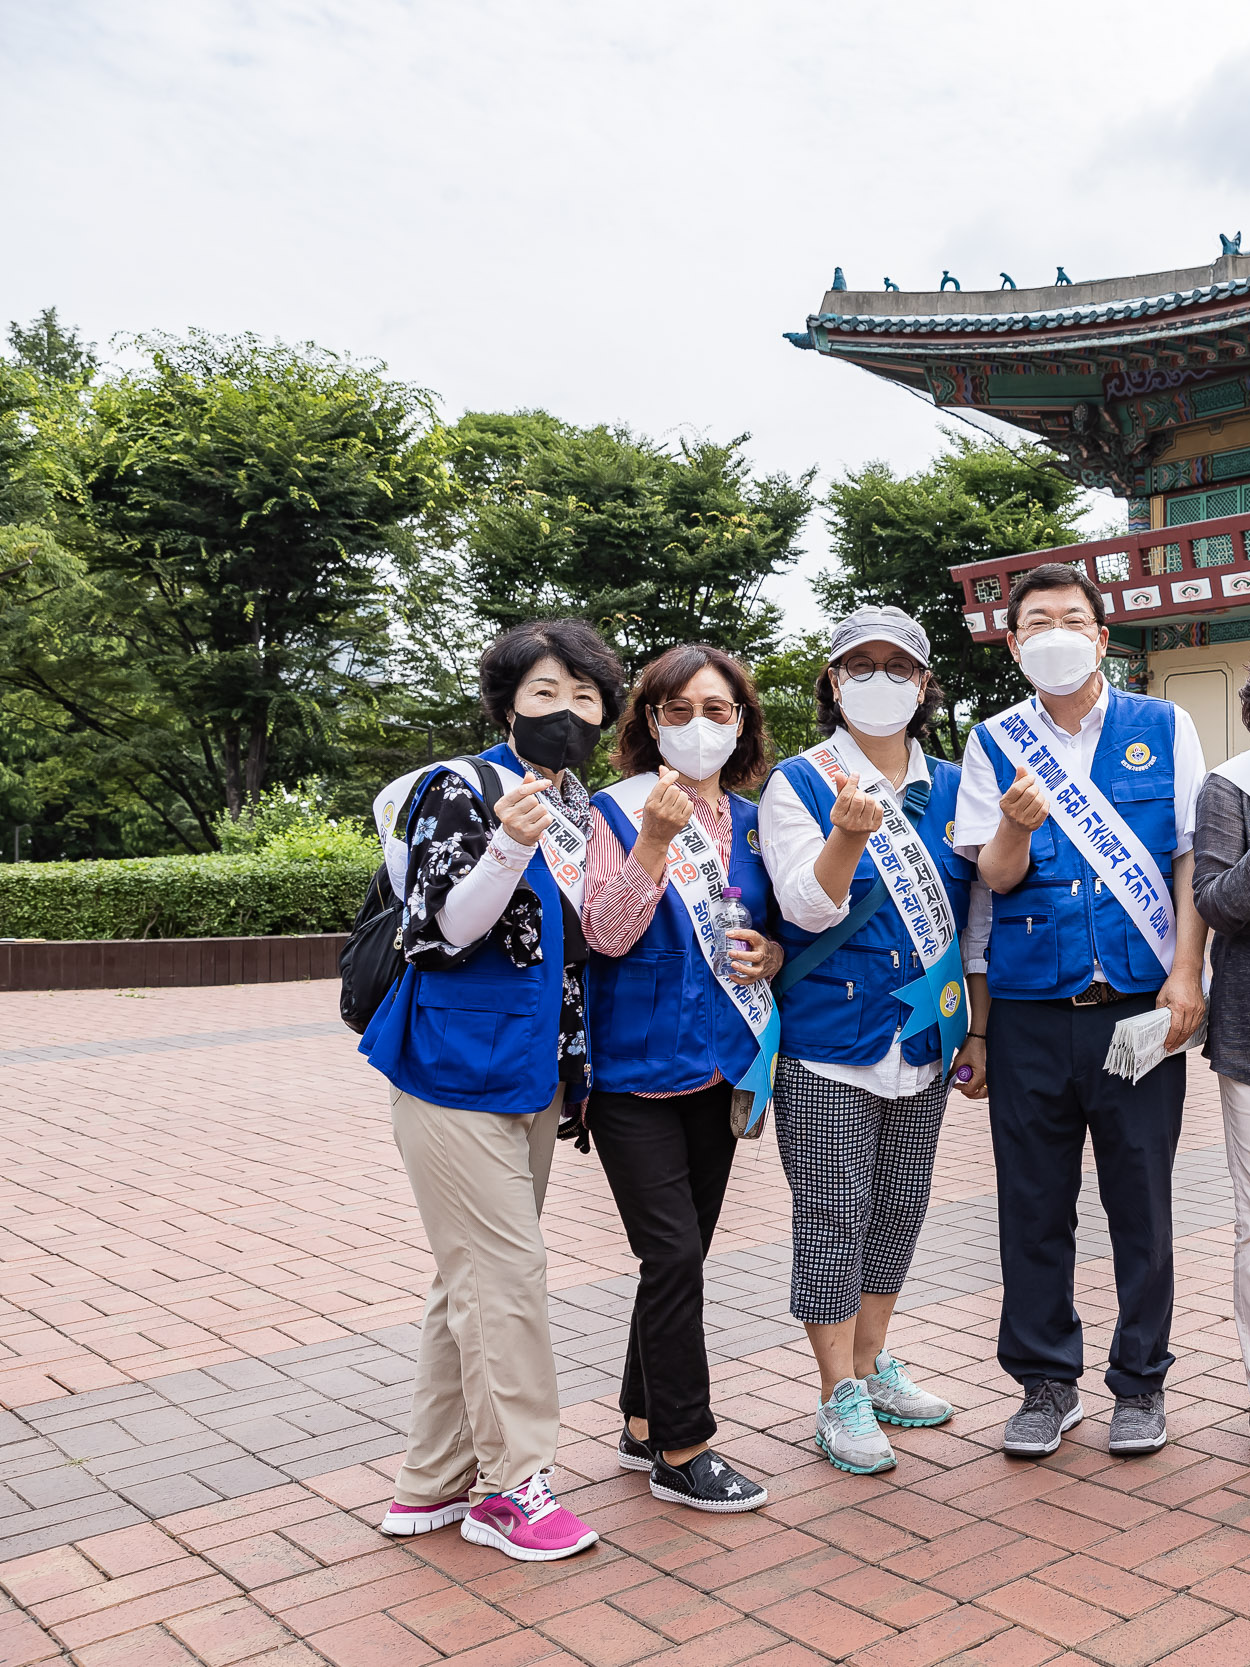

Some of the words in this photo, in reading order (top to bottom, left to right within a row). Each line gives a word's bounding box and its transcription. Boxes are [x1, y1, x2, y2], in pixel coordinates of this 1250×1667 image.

[1000, 713, 1038, 753] 법질서
[1027, 745, 1069, 791] 확립을
[1057, 783, 1090, 818] 위한
[1078, 811, 1131, 869] 기초질서
[1120, 863, 1158, 911] 지키기
[1150, 906, 1170, 940] 운동
[699, 858, 724, 903] 행락
[901, 842, 953, 947] 질서지키기
